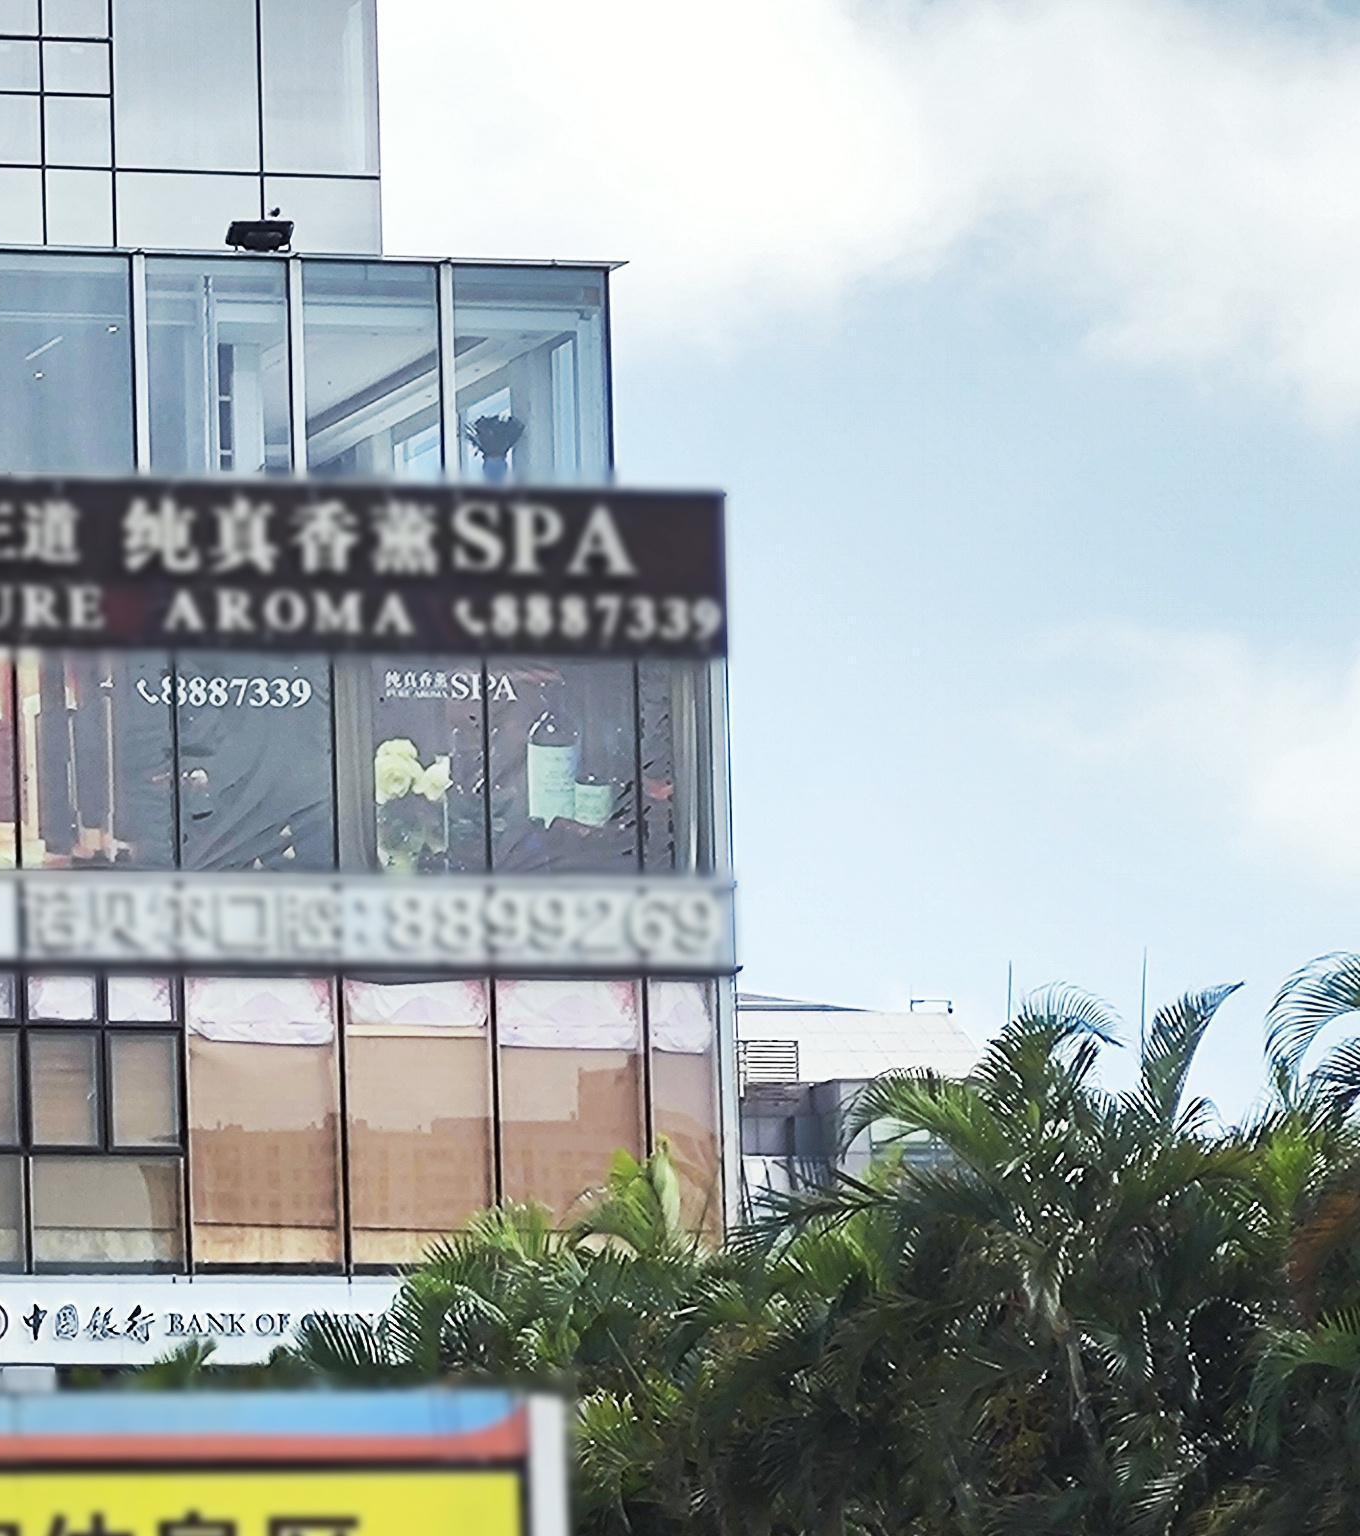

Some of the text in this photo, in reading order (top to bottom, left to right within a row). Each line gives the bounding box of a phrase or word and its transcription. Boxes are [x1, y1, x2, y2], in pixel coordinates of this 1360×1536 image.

[164, 588, 415, 636] AROMA
[491, 592, 723, 642] 8887339
[161, 676, 312, 707] 8887339
[450, 673, 518, 700] SPA
[22, 1303, 156, 1342] 中国银行
[165, 1312, 247, 1337] BANK
[254, 1313, 291, 1337] OF
